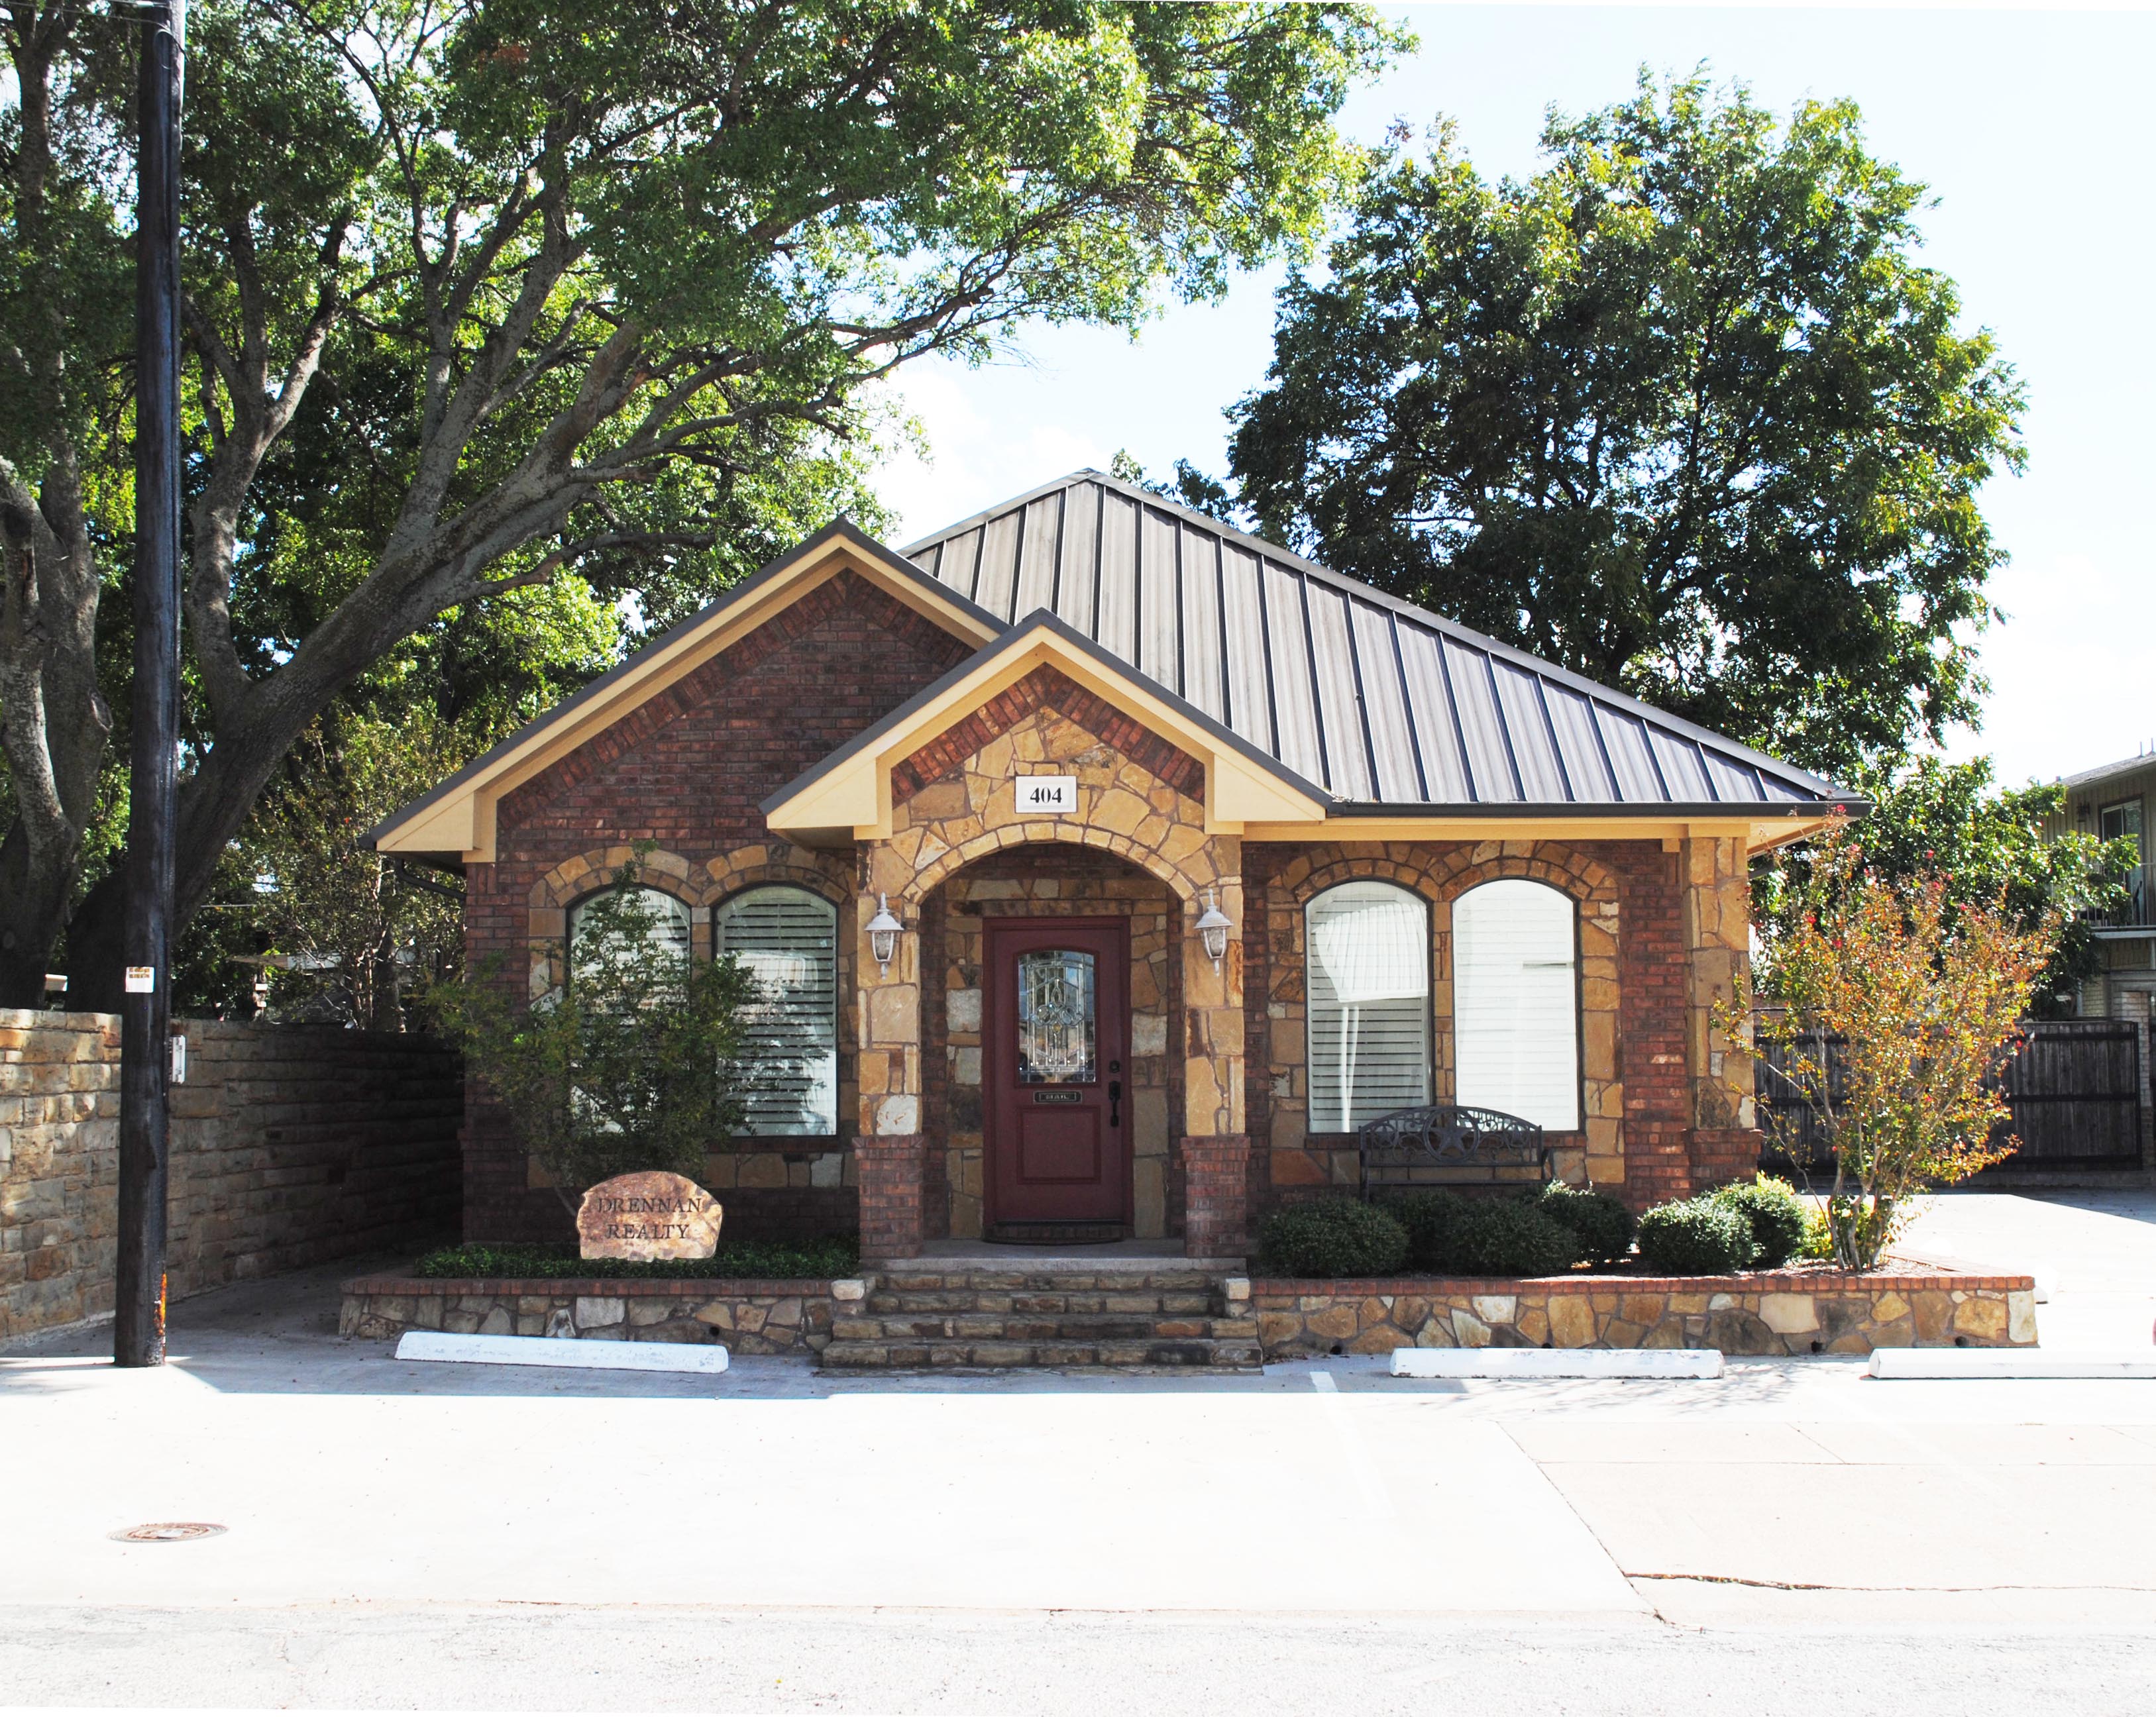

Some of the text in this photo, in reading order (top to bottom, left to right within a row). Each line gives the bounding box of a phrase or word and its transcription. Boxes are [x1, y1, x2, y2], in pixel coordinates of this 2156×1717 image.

[1030, 787, 1062, 804] 404
[598, 1197, 702, 1213] DRENNAN
[606, 1224, 690, 1239] REALTY
